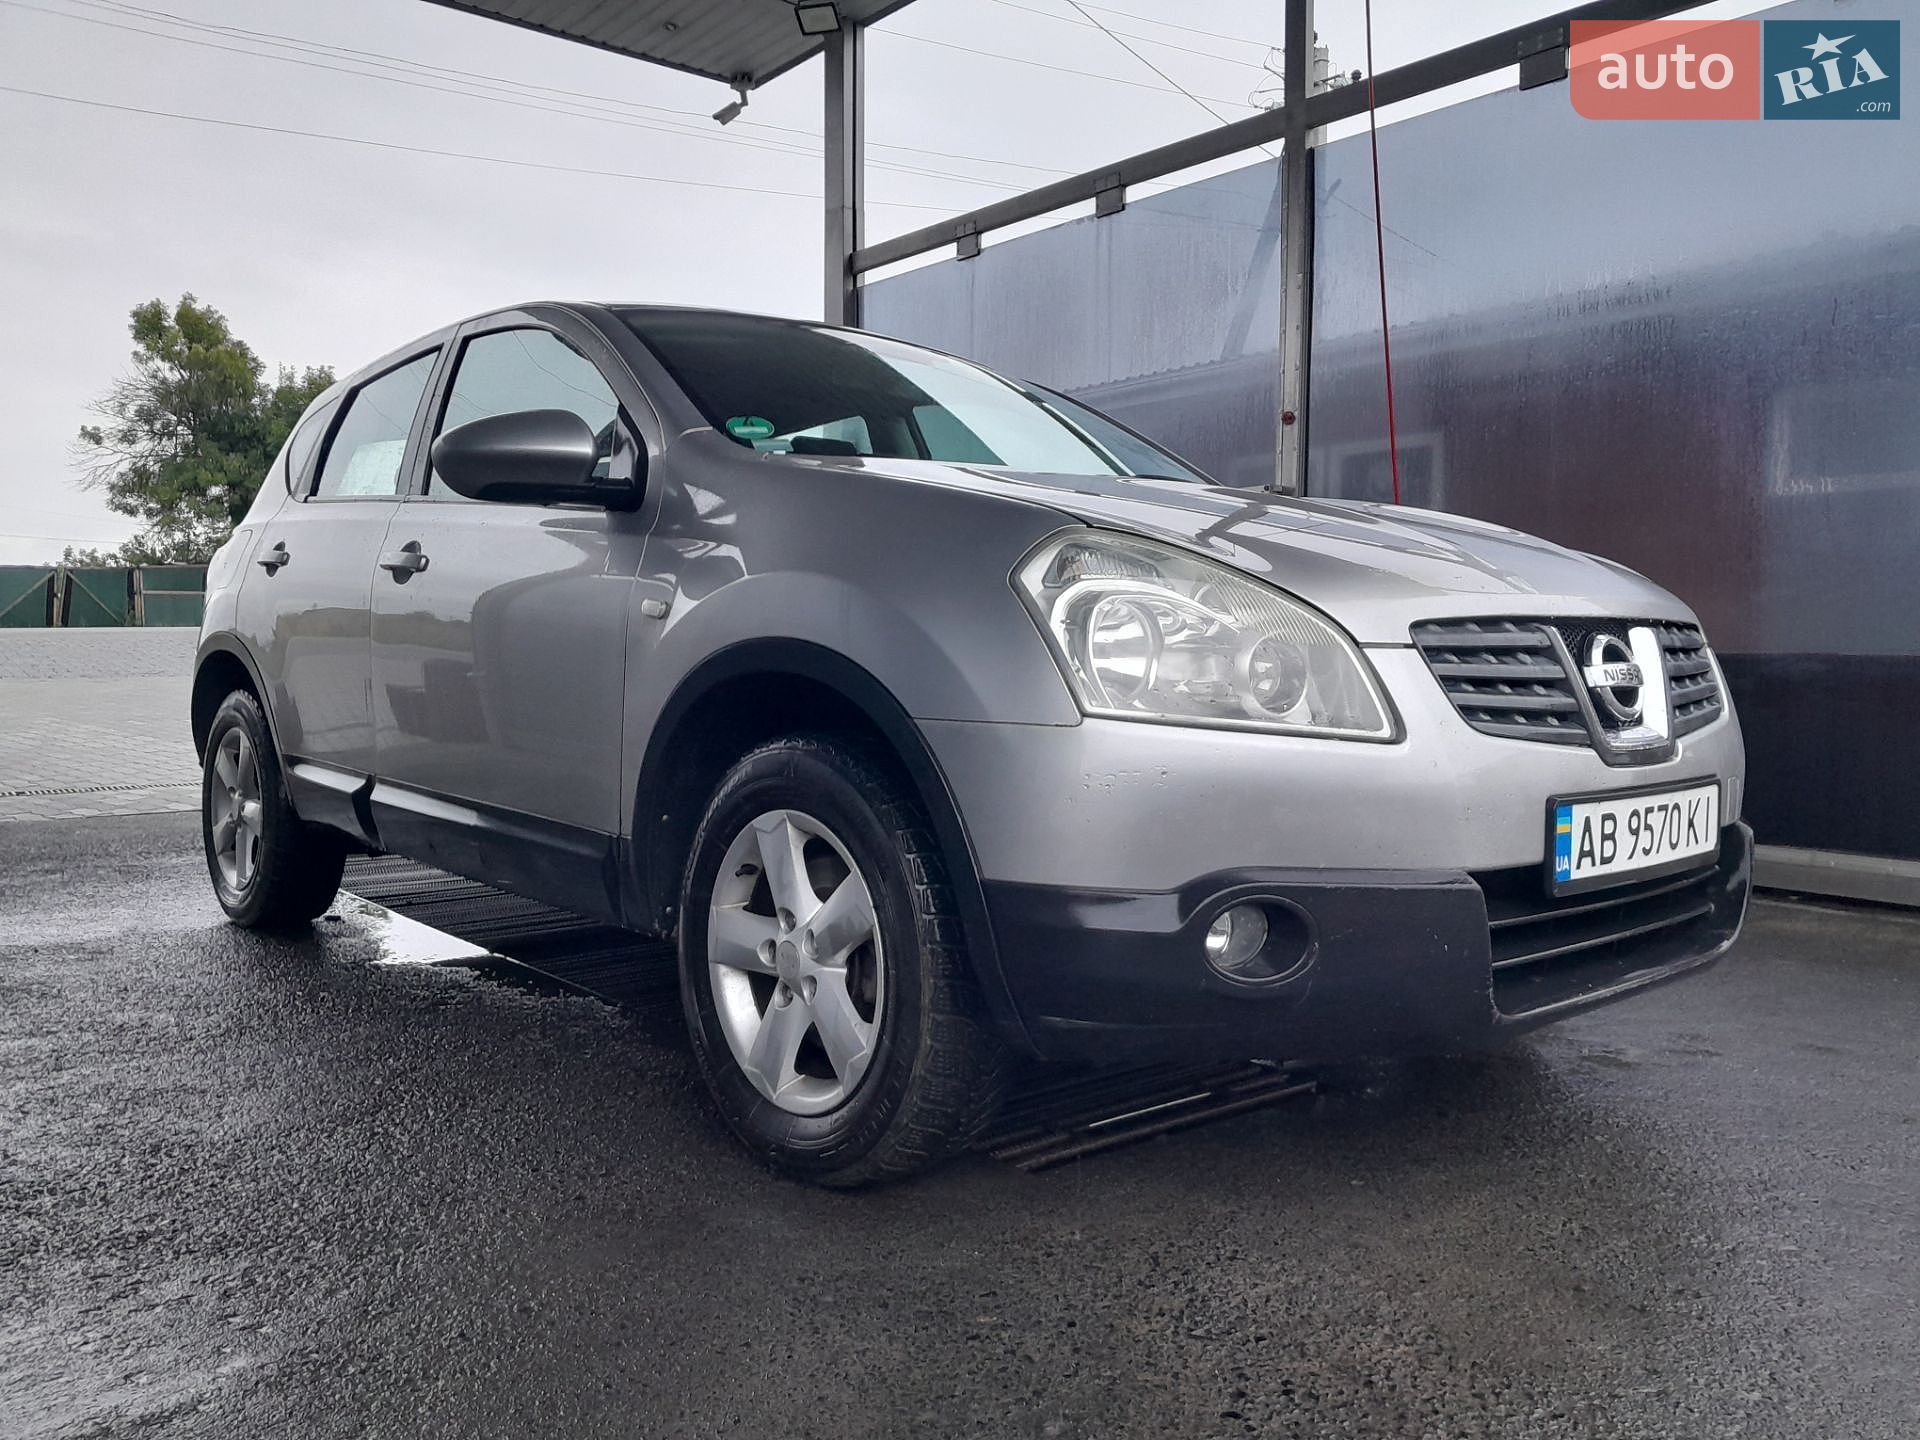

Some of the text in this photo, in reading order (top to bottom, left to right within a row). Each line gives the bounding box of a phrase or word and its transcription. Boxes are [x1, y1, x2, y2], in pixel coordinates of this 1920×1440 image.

[1576, 796, 1710, 870] AB 9570 KI
[1556, 856, 1570, 872] UA
